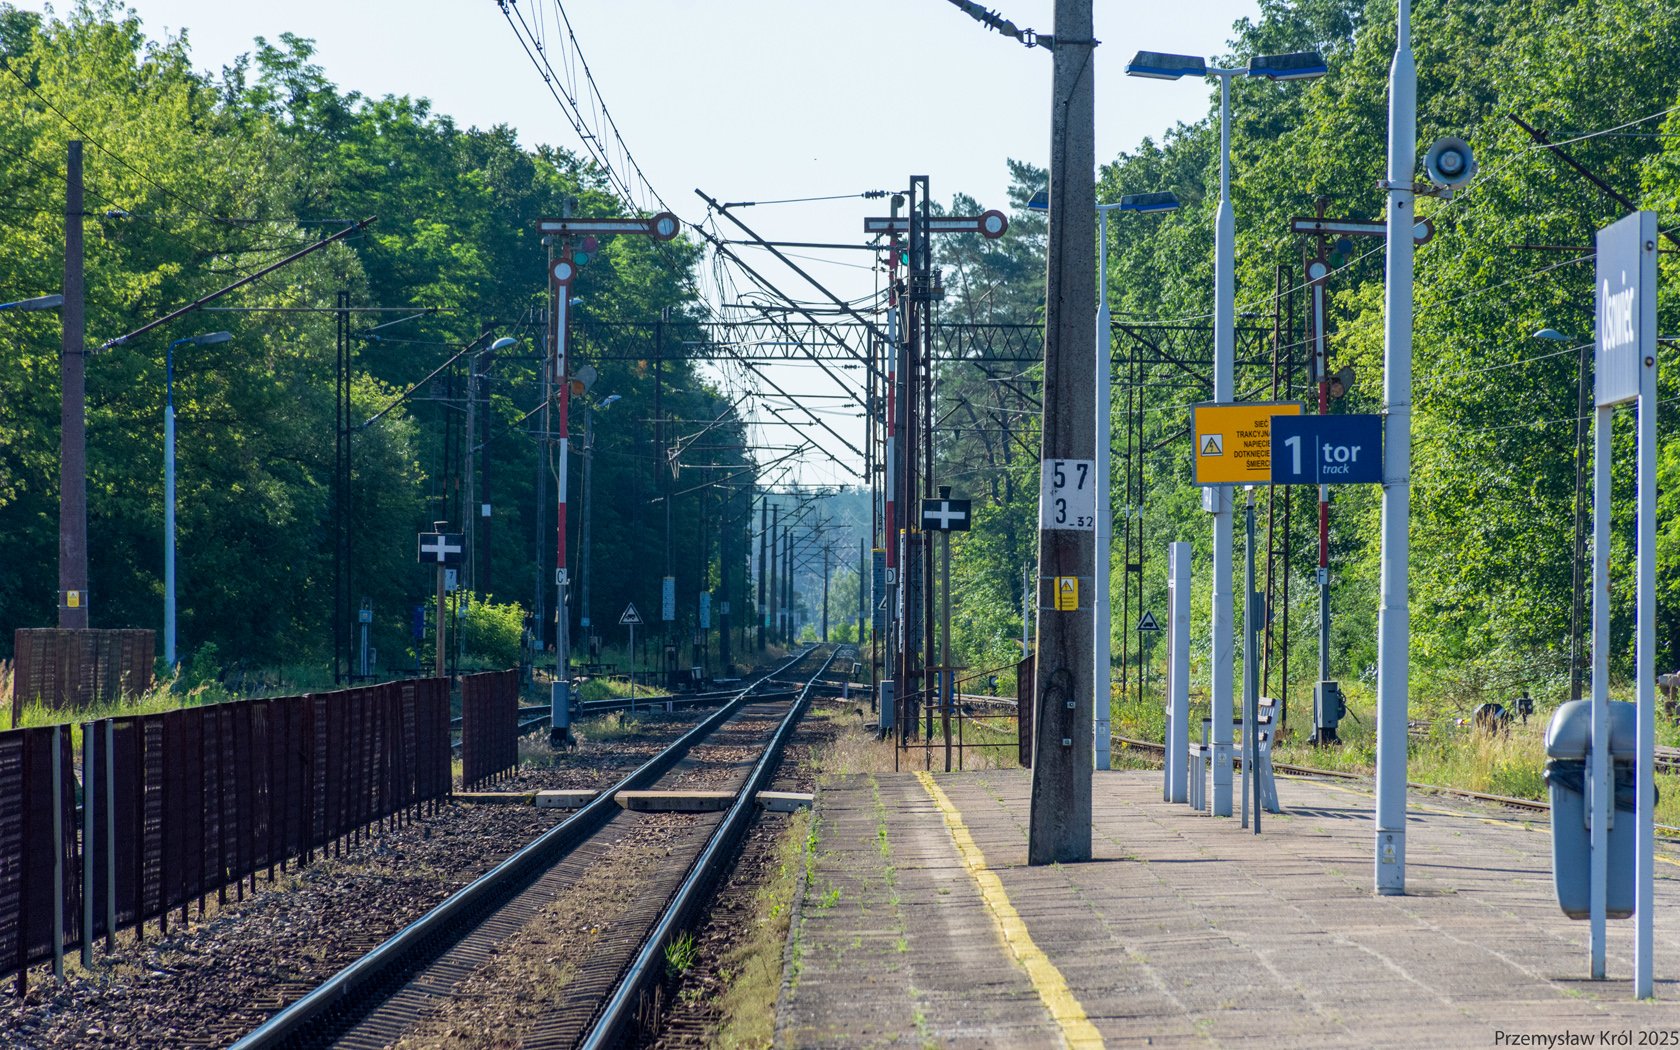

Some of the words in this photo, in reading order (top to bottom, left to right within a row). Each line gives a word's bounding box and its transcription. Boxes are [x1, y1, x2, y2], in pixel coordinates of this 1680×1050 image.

[1254, 419, 1269, 428] SIEĆ
[1236, 430, 1271, 438] TRAKCYJN
[1284, 435, 1302, 475] 1
[1322, 442, 1361, 463] tor
[1246, 459, 1271, 468] ŚMIERC
[1322, 463, 1350, 474] track
[557, 570, 564, 583] C
[887, 570, 894, 582] D
[1318, 570, 1324, 582] F
